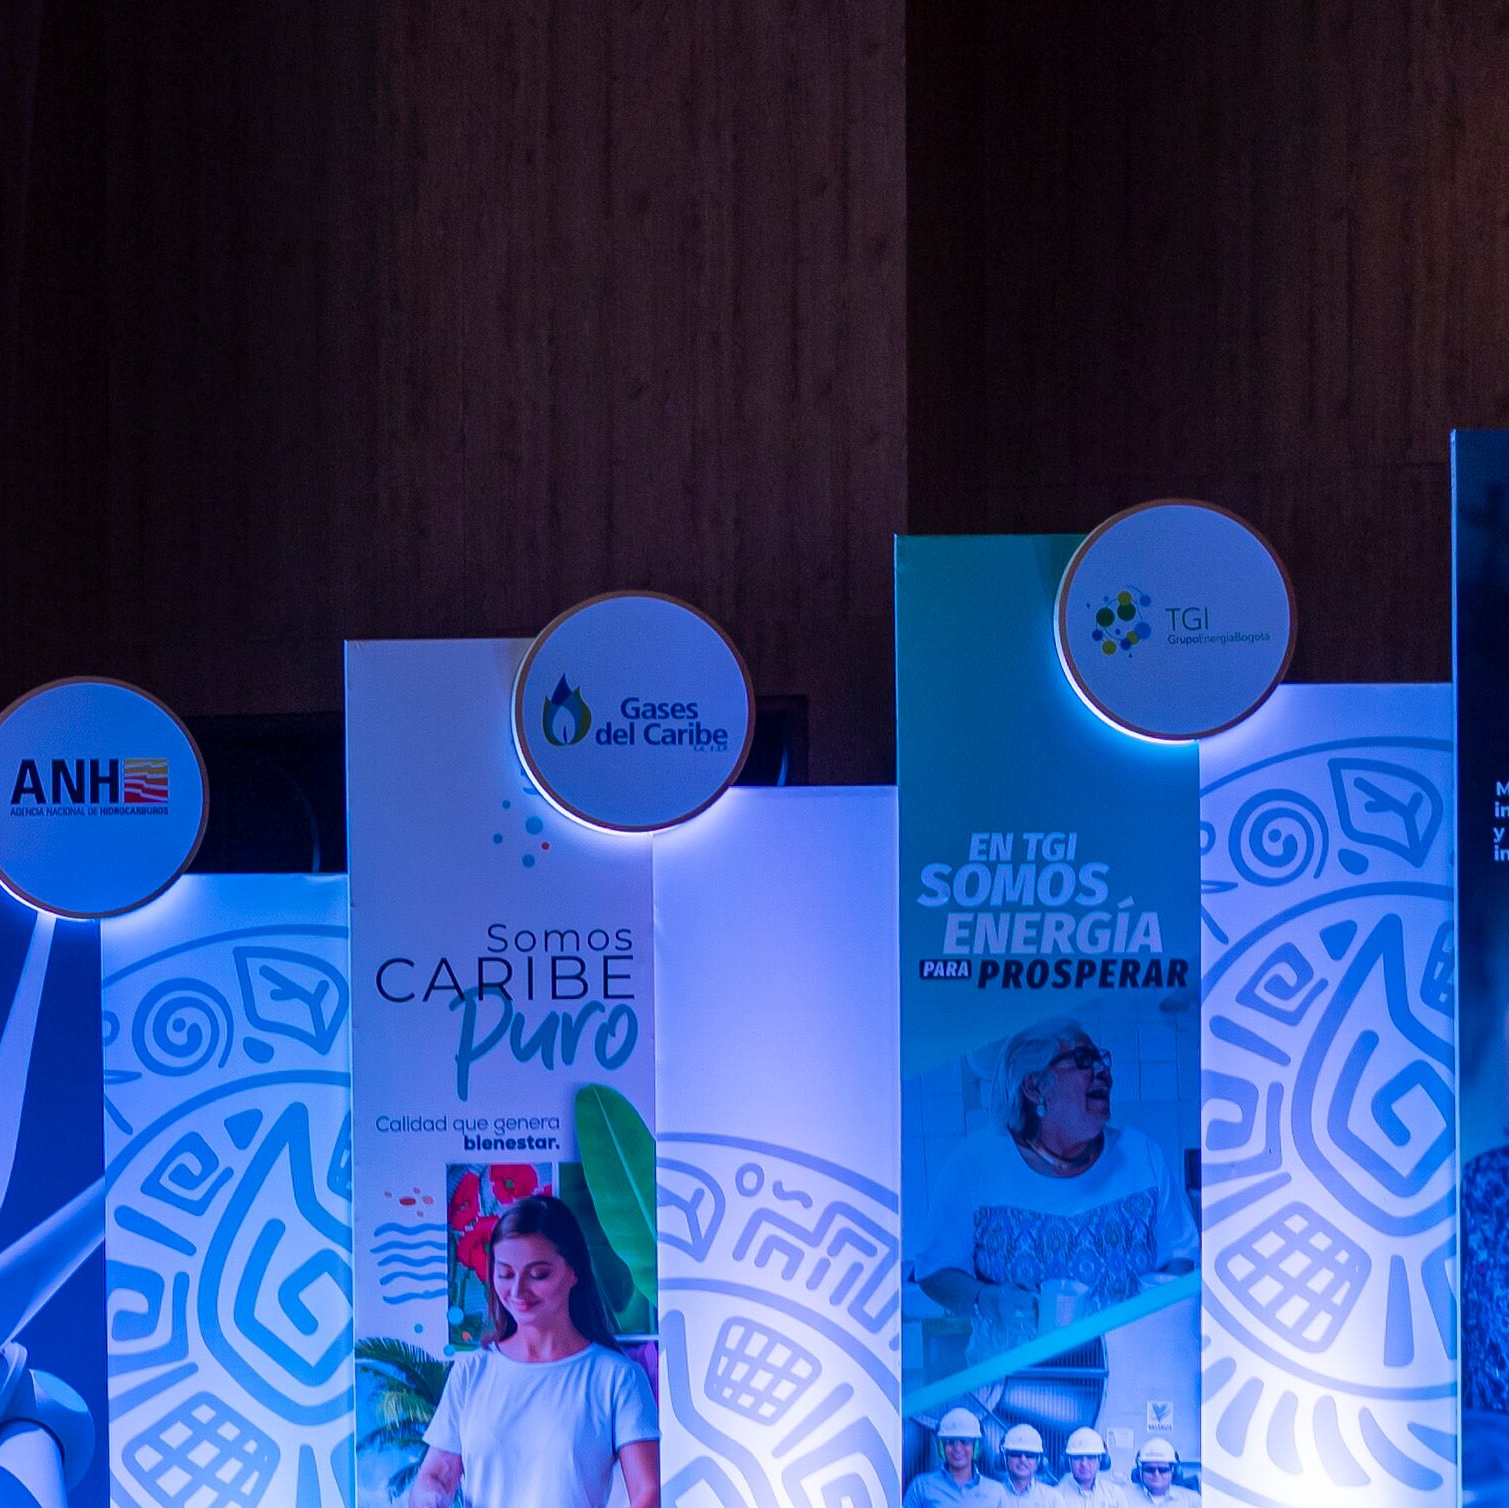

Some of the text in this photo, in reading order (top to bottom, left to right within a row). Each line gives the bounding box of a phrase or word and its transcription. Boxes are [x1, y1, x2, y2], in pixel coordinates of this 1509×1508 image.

[1165, 607, 1209, 631] TGI
[621, 697, 699, 720] Gases
[595, 722, 728, 746] del Caribe
[10, 758, 119, 805] ANH
[10, 806, 46, 816] AGENCIA
[47, 806, 86, 816] NACIONAL
[100, 806, 169, 816] HIDROCARBUROS
[968, 832, 1077, 861] EN TGI
[917, 862, 1110, 908] SOMOS
[487, 923, 633, 953] Somos
[942, 896, 1164, 954] ENERGÍA
[376, 954, 635, 1003] CARIBE
[922, 958, 1190, 989] PARA PROSPERAR
[448, 985, 638, 1102] Puro
[376, 1115, 560, 1138] Calidad que genera
[464, 1135, 561, 1152] bienestar.
